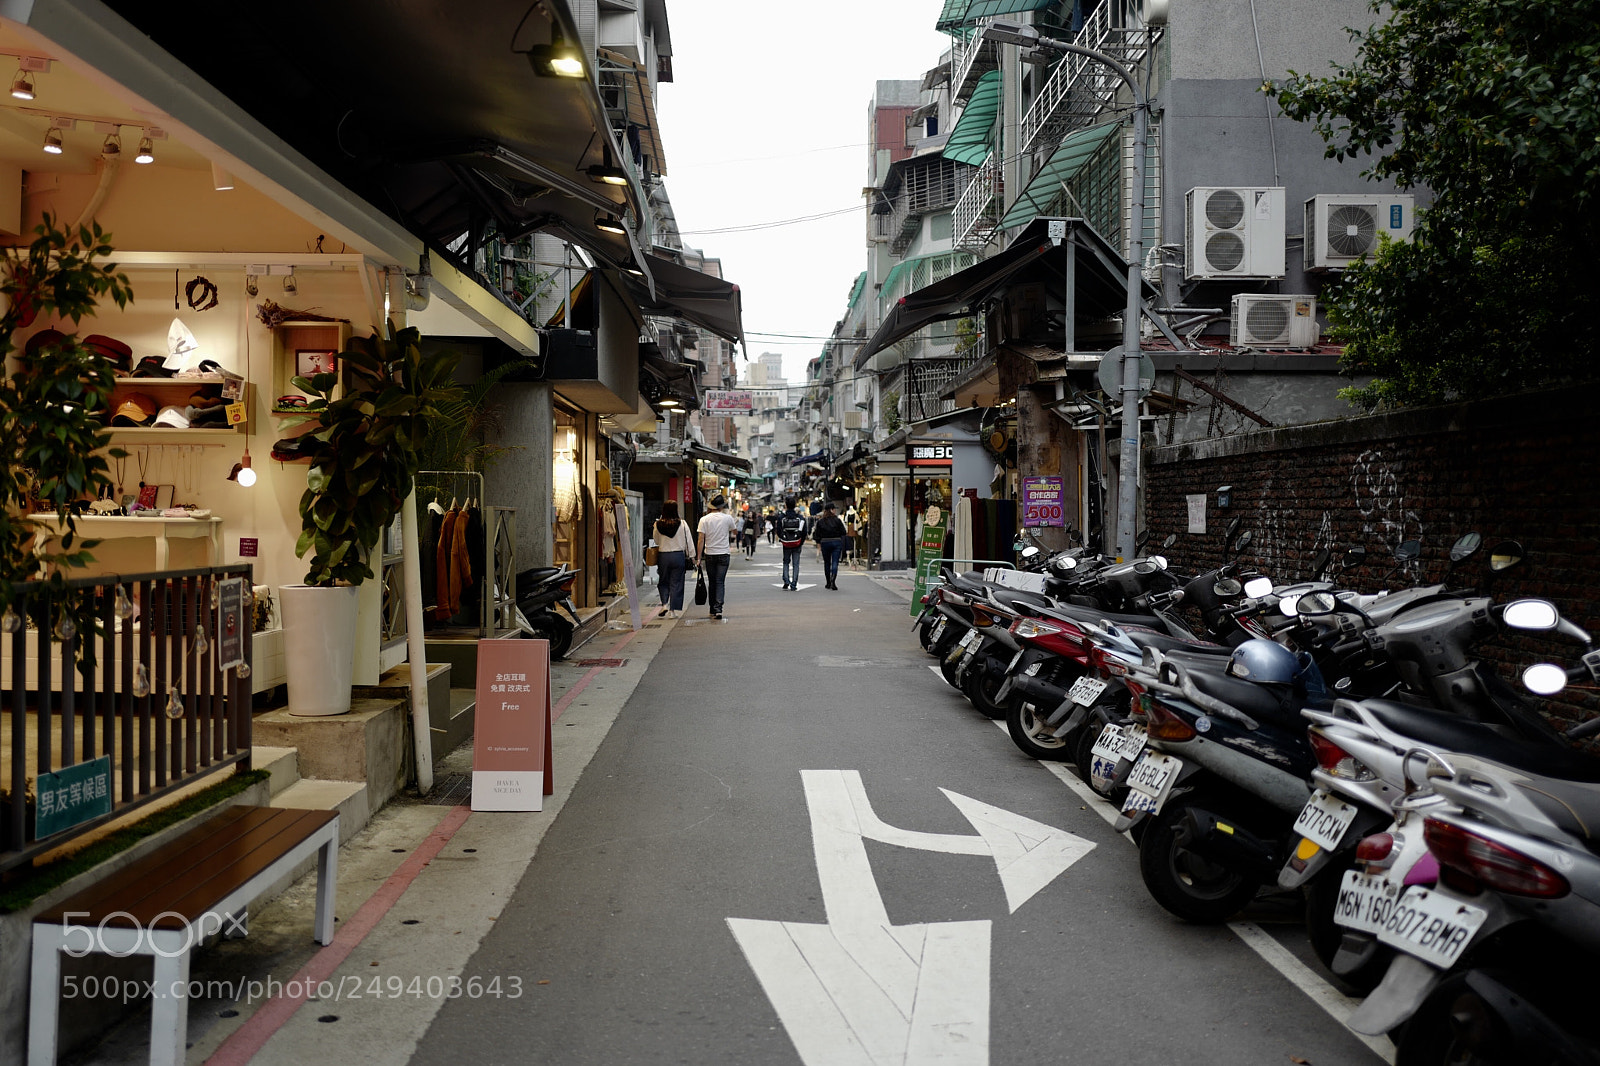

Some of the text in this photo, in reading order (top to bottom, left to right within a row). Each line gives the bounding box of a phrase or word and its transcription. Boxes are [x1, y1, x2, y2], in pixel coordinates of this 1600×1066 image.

[1026, 505, 1062, 520] 500
[490, 684, 531, 693] 免費 改夾式
[495, 673, 526, 682] 全店耳環
[501, 702, 520, 711] Free
[1130, 761, 1168, 791] 916-BLZ
[41, 773, 107, 818] 男友等候區
[1299, 803, 1347, 844] 677-CXW
[1387, 905, 1468, 960] 607-BMR
